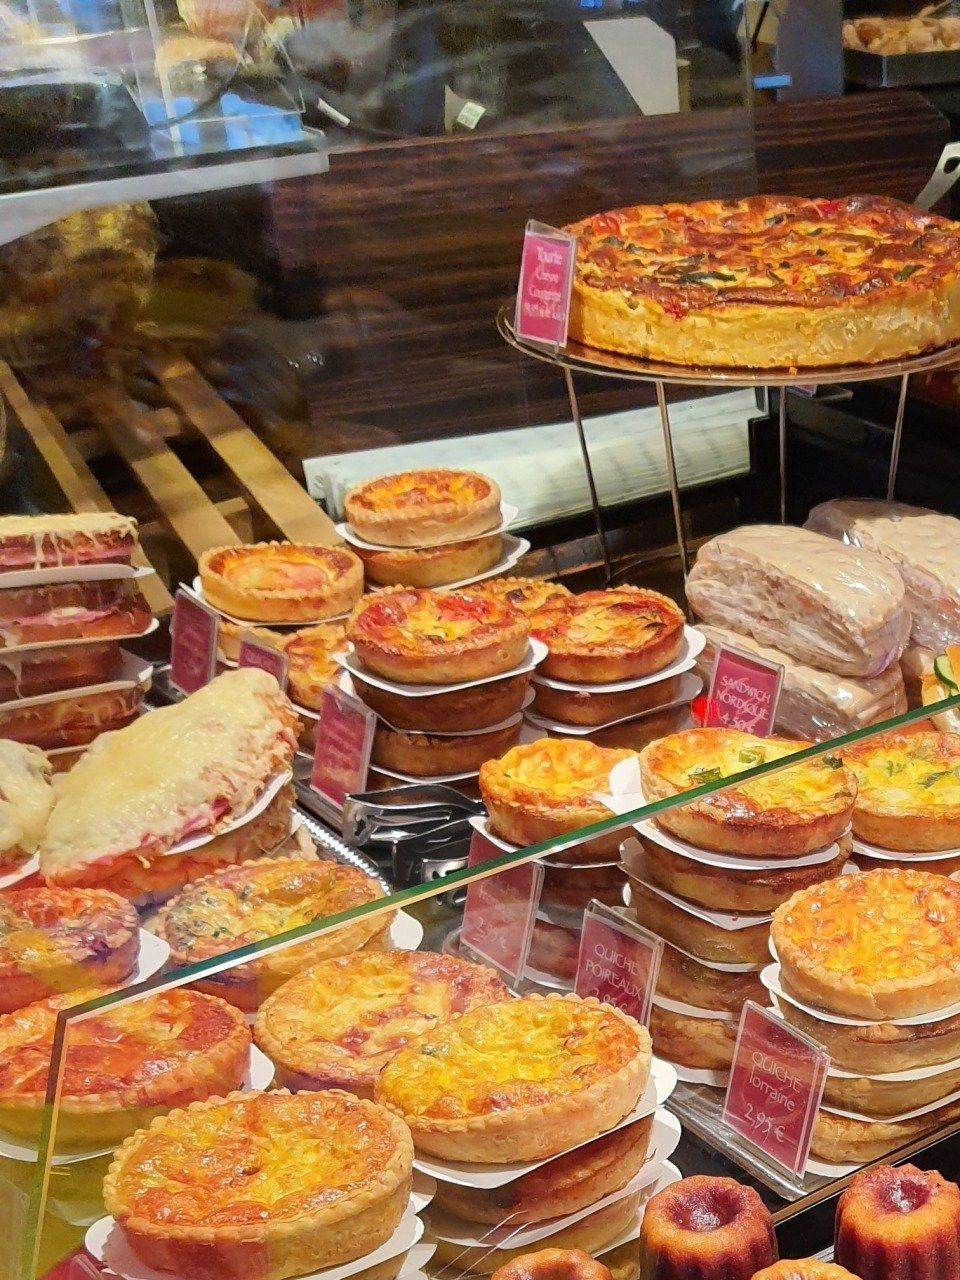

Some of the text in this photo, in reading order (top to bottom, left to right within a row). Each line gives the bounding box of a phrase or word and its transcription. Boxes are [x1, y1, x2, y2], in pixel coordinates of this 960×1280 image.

[716, 690, 770, 721] NORDIQUE
[720, 676, 771, 704] SANDWICH
[595, 944, 639, 976] QUICHE
[586, 959, 642, 1001] POIREAUX
[749, 1063, 795, 1112] lorraine
[753, 1051, 803, 1094] QUICHE
